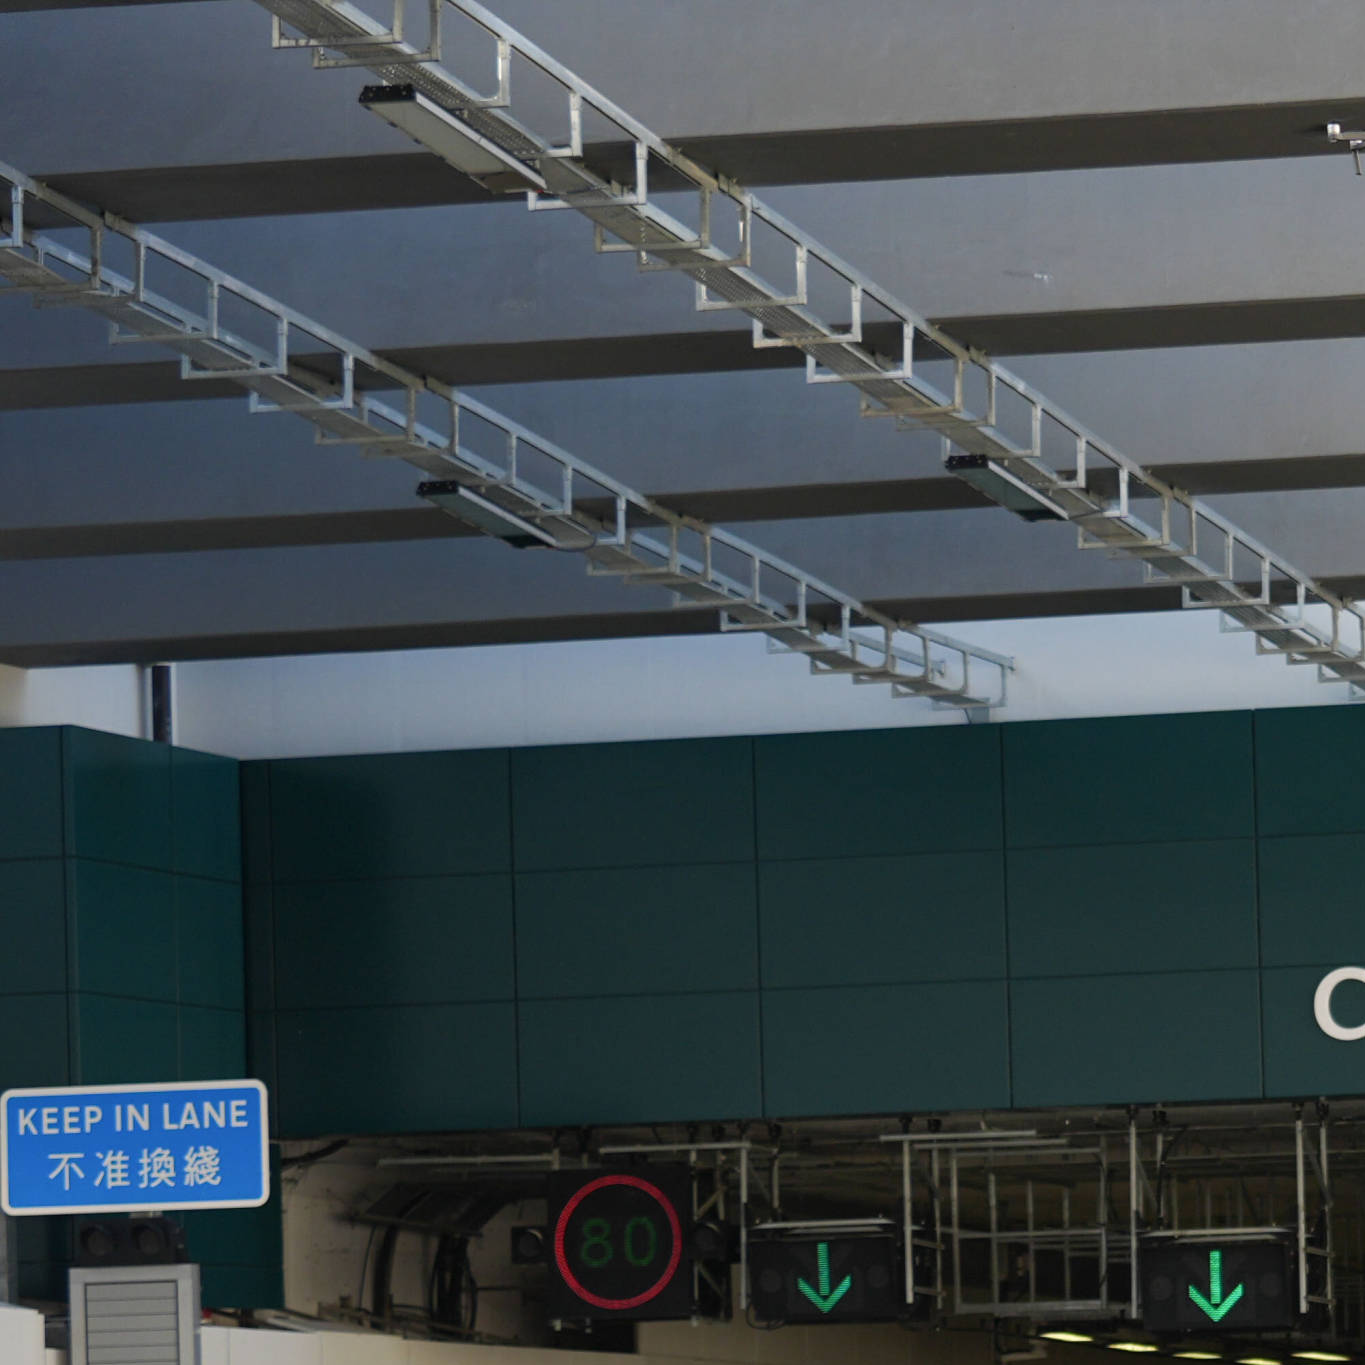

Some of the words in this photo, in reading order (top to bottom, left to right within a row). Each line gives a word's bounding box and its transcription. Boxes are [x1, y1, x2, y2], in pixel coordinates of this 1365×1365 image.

[18, 1106, 102, 1135] KEEP
[115, 1103, 149, 1131] IN
[163, 1099, 248, 1130] LANE
[47, 1146, 222, 1191] 不准換綫
[580, 1216, 658, 1268] 80
